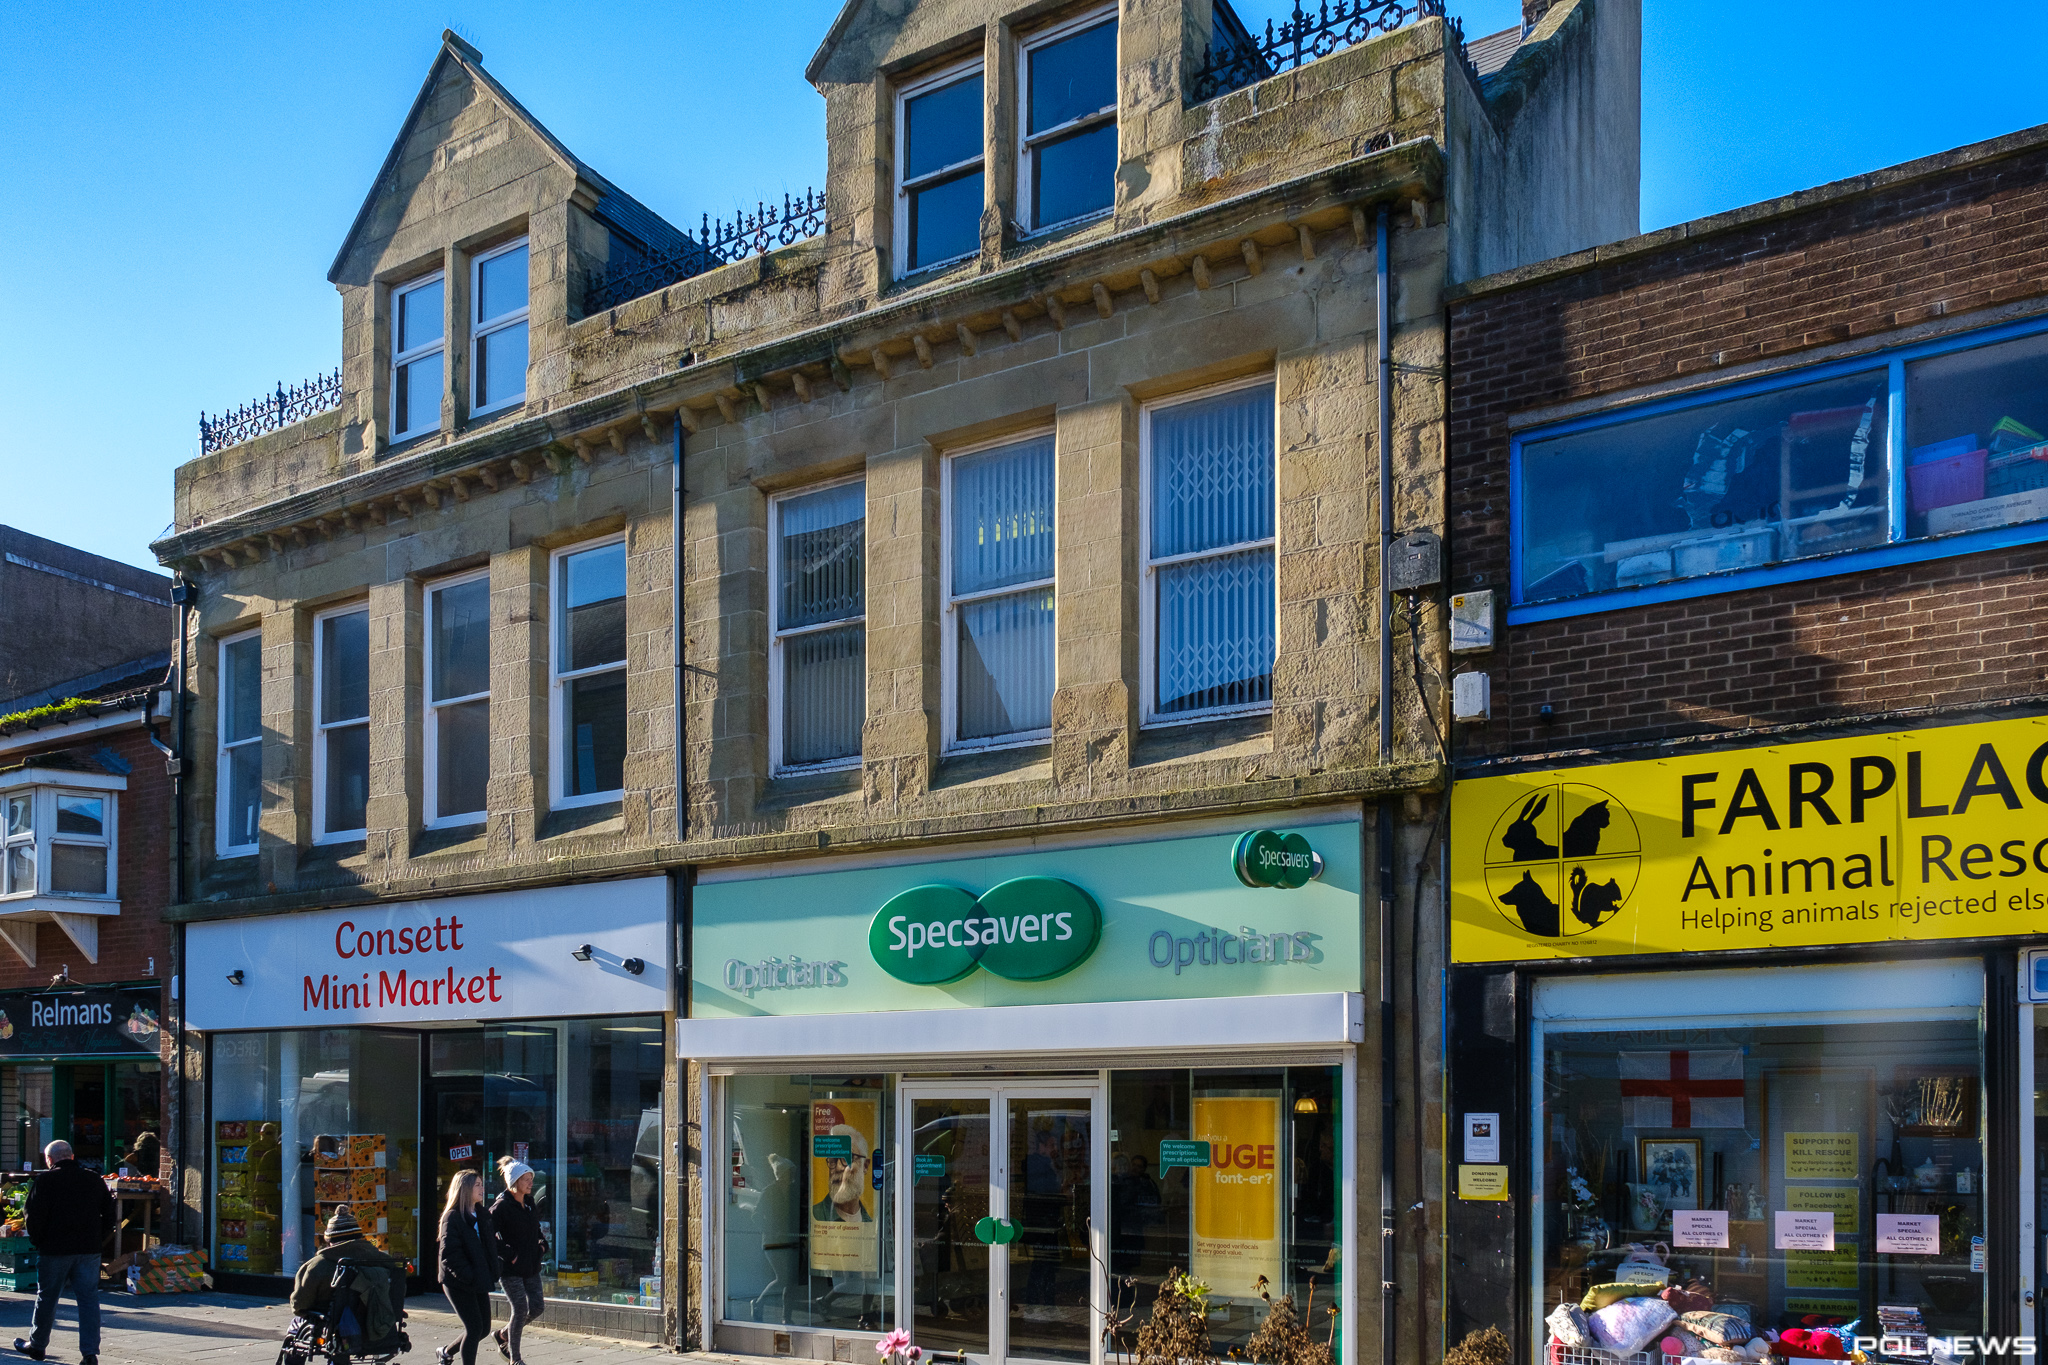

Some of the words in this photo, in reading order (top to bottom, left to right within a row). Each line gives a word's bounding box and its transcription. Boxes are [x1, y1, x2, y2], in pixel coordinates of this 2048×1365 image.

[1951, 509, 1978, 519] TORNADO
[1978, 505, 2005, 514] CONTOUR
[2006, 500, 2032, 509] AVENGER
[1455, 597, 1463, 607] 5
[1259, 844, 1310, 869] Specsavers
[1681, 835, 1895, 903] Animal
[1681, 907, 1774, 935] Helping
[1782, 900, 1879, 925] animals
[1889, 889, 1997, 924] rejected
[335, 915, 464, 959] Consett
[888, 912, 1073, 959] Specsavers
[1149, 925, 1315, 976] Opticians
[303, 972, 372, 1011] Mini
[378, 966, 502, 1008] Market
[723, 954, 843, 998] Opticians
[32, 998, 112, 1027] Relmans
[815, 1107, 832, 1116] Free
[451, 1147, 470, 1159] OPEN
[1208, 1143, 1275, 1170] UGE
[1215, 1170, 1273, 1185] font-er?
[1217, 1242, 1231, 1250] good
[1809, 1258, 1834, 1266] HERE
[1820, 1303, 1857, 1311] BARGAIN
